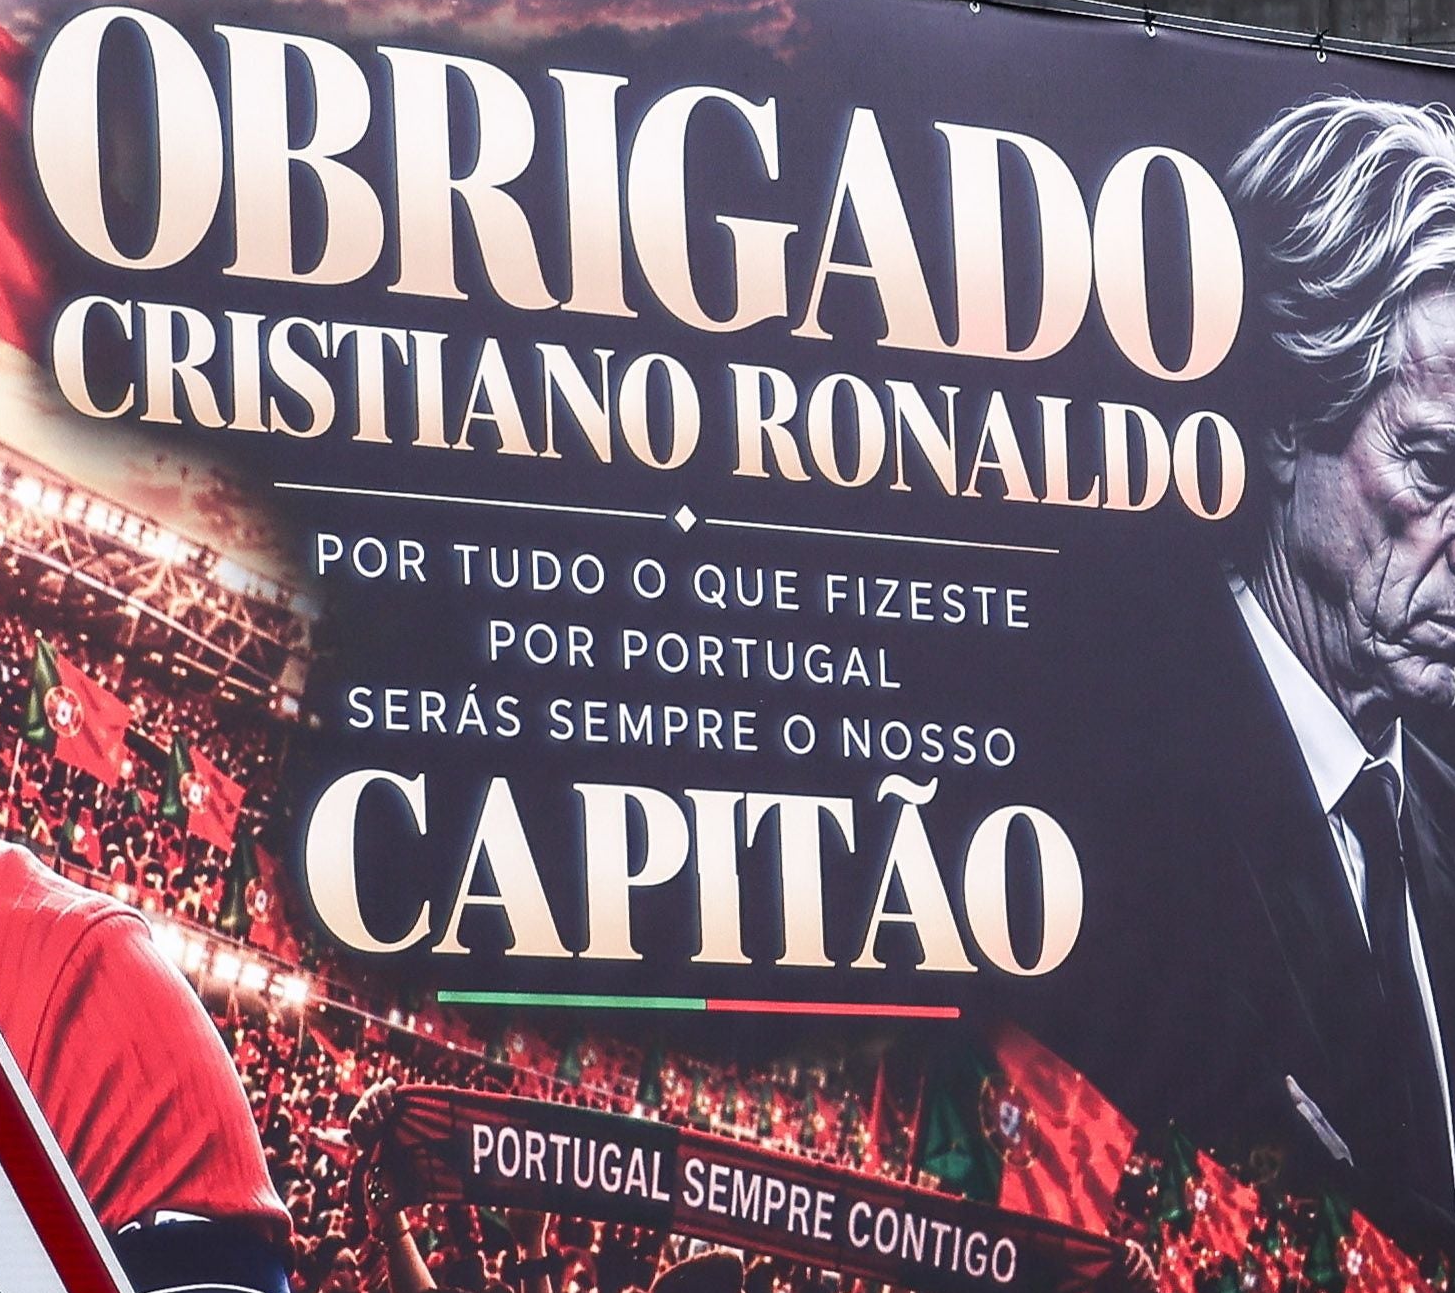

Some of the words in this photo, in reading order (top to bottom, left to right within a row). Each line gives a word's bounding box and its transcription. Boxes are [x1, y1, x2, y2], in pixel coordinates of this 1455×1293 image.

[30, 7, 1244, 383] OBRIGADO
[51, 296, 702, 473] CRISTIANO
[728, 363, 1247, 521] RONALDO
[316, 532, 426, 583] POR
[453, 543, 605, 596] TUDO
[632, 559, 666, 599] O
[693, 564, 801, 612] QUE
[826, 575, 1029, 629] FIZESTE
[490, 621, 594, 668] POR
[624, 629, 900, 689] PORTUGAL
[347, 683, 521, 737] SERÁS
[548, 700, 759, 752] SEMPRE
[783, 715, 816, 755] O
[843, 718, 1017, 767] NOSSO
[304, 768, 1084, 976] CAPITÃO
[471, 1123, 671, 1202] PORTUGAL
[682, 1160, 833, 1241] SEMPRE
[848, 1206, 1017, 1285] CONTIGO
